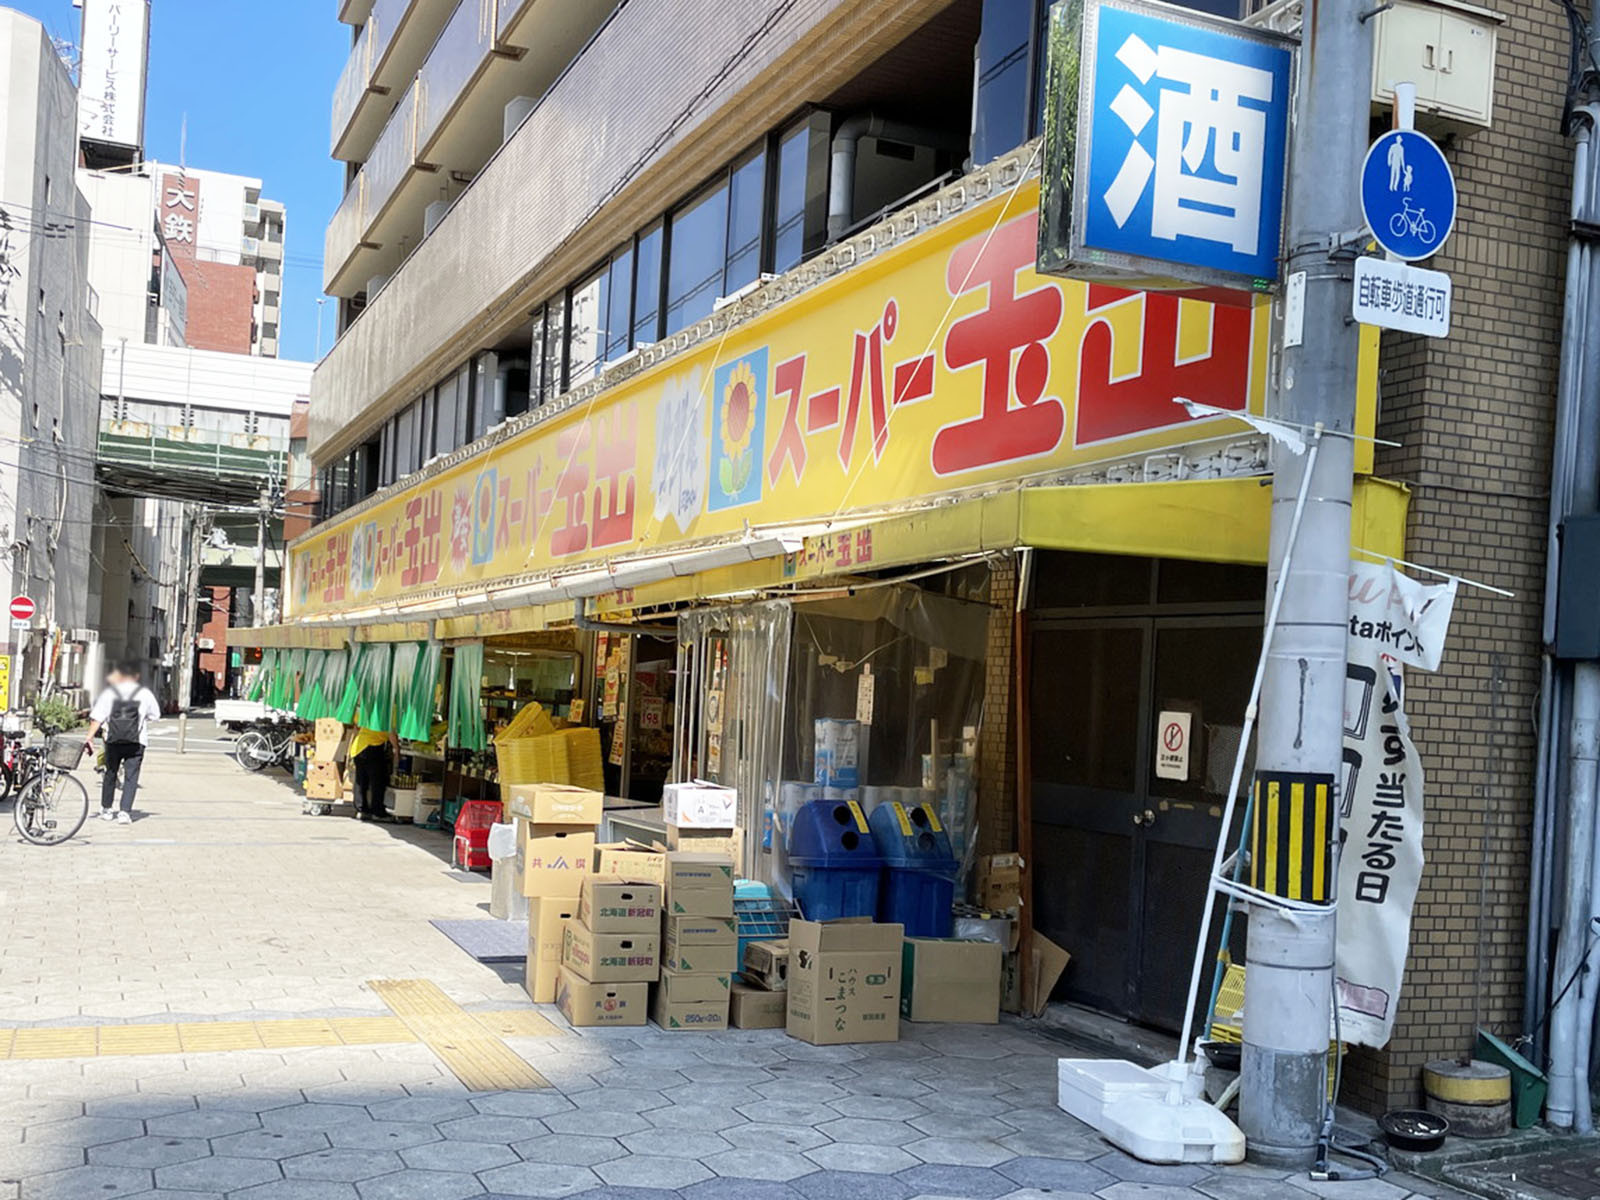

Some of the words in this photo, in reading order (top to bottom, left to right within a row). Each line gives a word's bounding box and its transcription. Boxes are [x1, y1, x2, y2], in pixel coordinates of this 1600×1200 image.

[1103, 32, 1273, 256] 酒
[1359, 274, 1447, 322] 自転車歩道通行可
[496, 401, 638, 557] スーパー玉出
[834, 972, 847, 1032] こまつな
